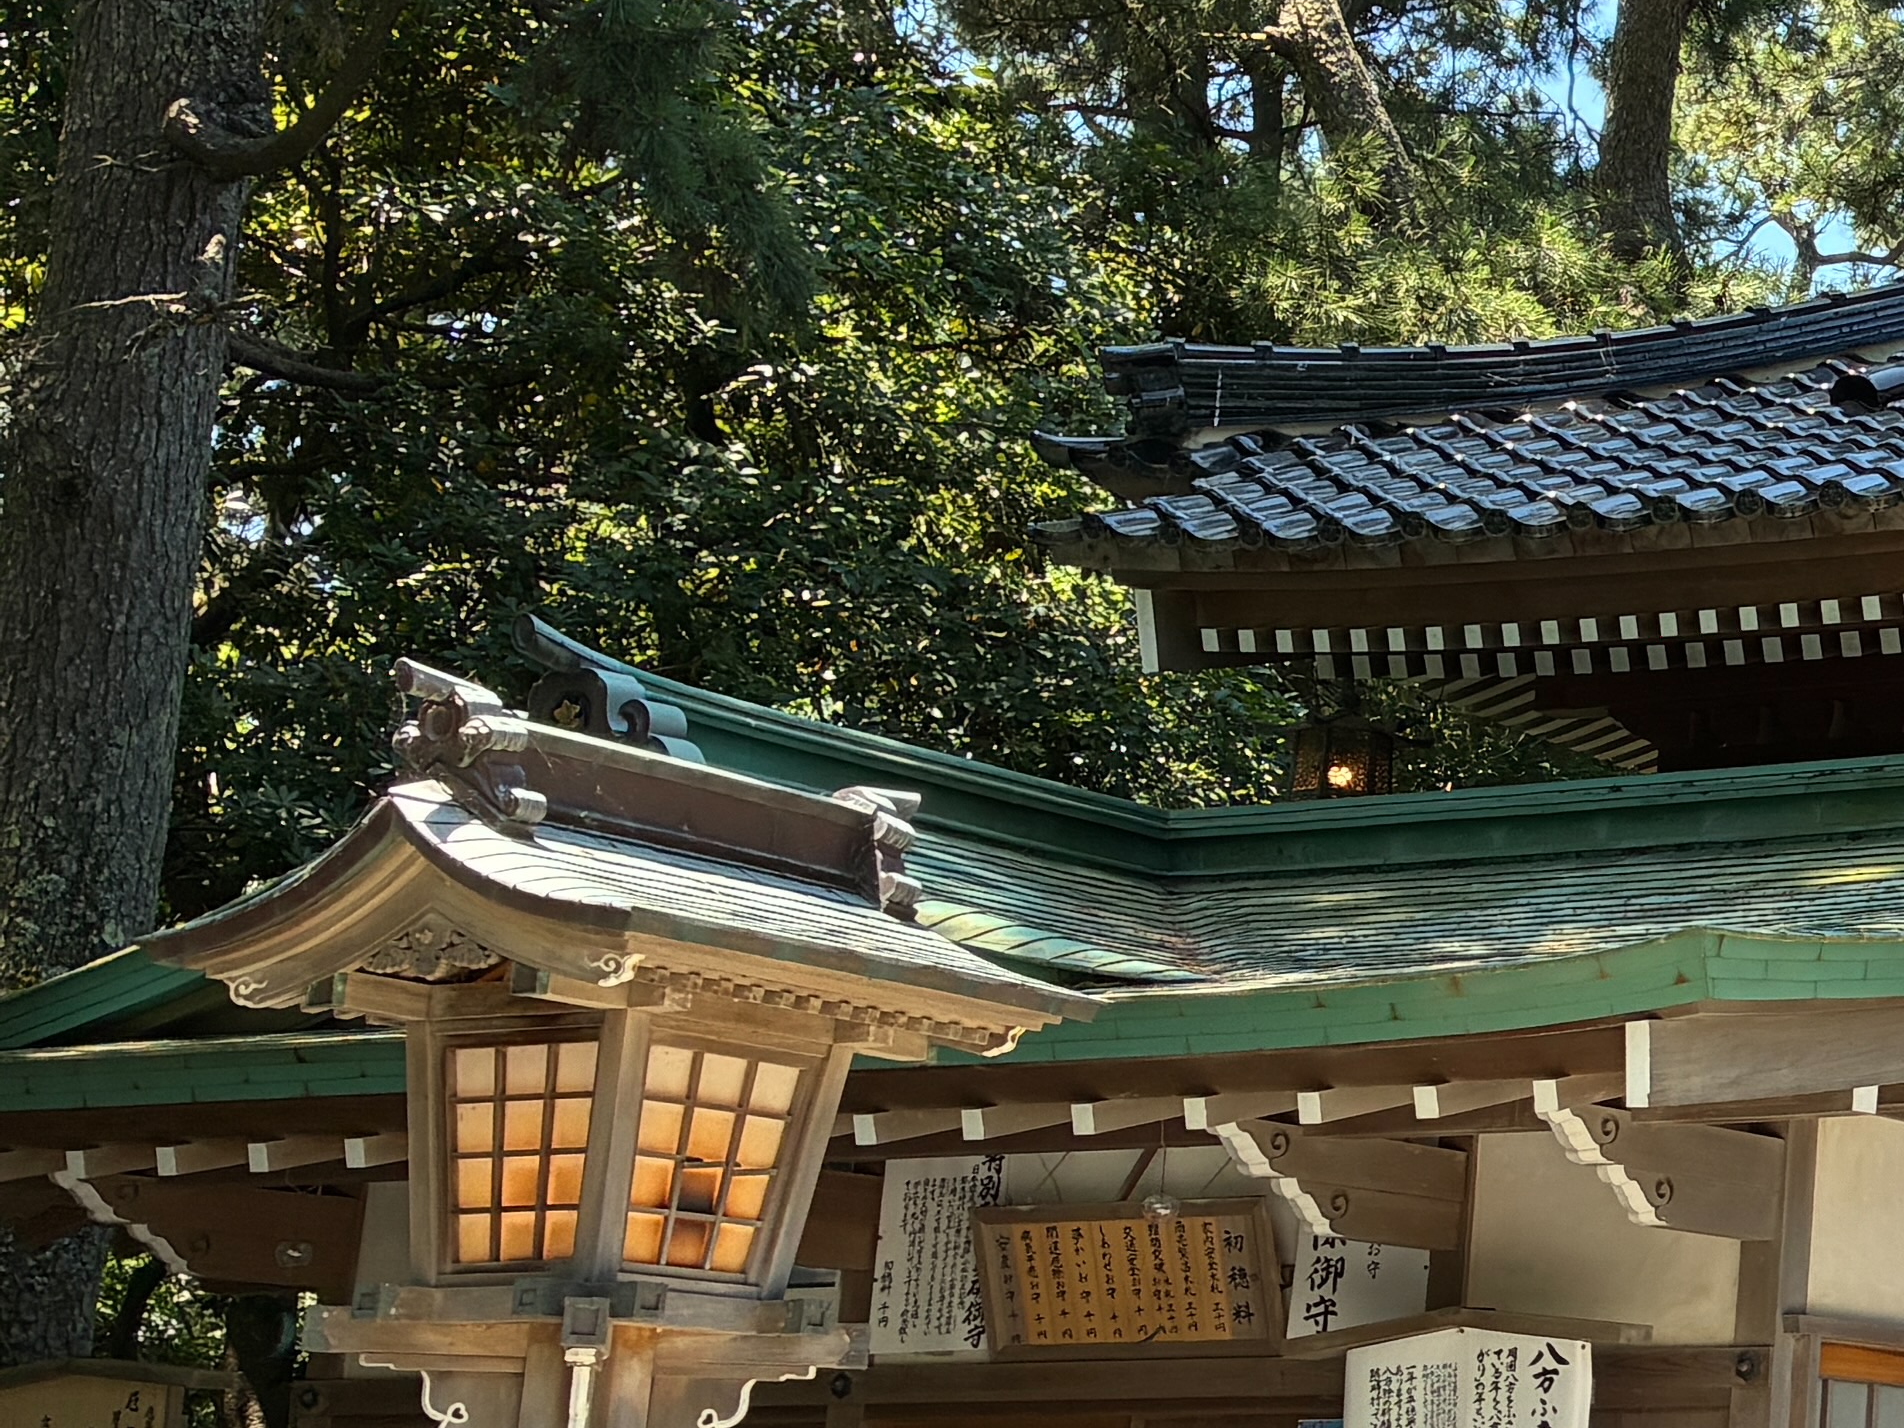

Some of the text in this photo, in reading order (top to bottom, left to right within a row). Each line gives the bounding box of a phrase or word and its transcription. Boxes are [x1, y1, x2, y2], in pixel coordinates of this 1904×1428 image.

[1223, 1229, 1254, 1326] 初穂料
[1059, 1308, 1073, 1339] 千円
[1084, 1310, 1097, 1338] 千円
